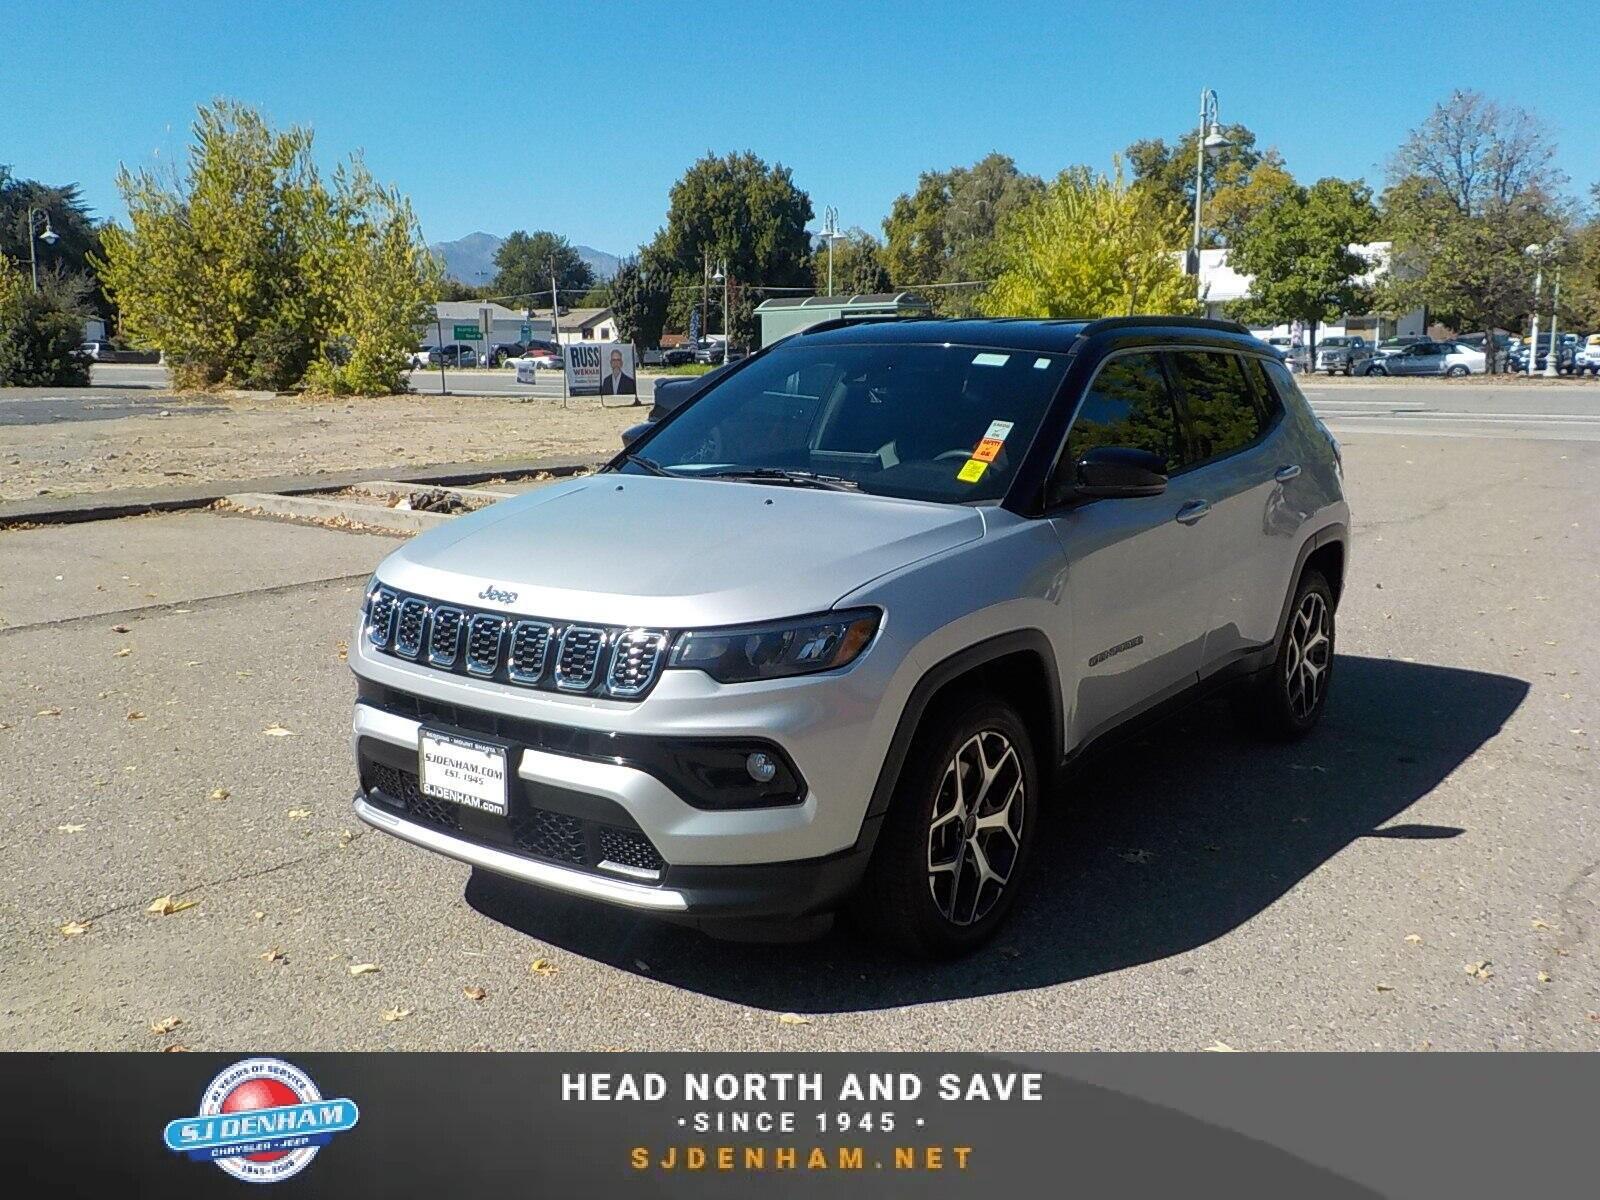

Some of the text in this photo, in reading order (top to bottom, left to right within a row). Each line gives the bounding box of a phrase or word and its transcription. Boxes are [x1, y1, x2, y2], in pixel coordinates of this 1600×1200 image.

[570, 346, 600, 368] RUSS
[478, 584, 518, 605] Jeep
[425, 753, 502, 780] SJDENHAM.COM
[444, 768, 484, 786] EST. 1945
[423, 783, 503, 815] SJDENHAM.com
